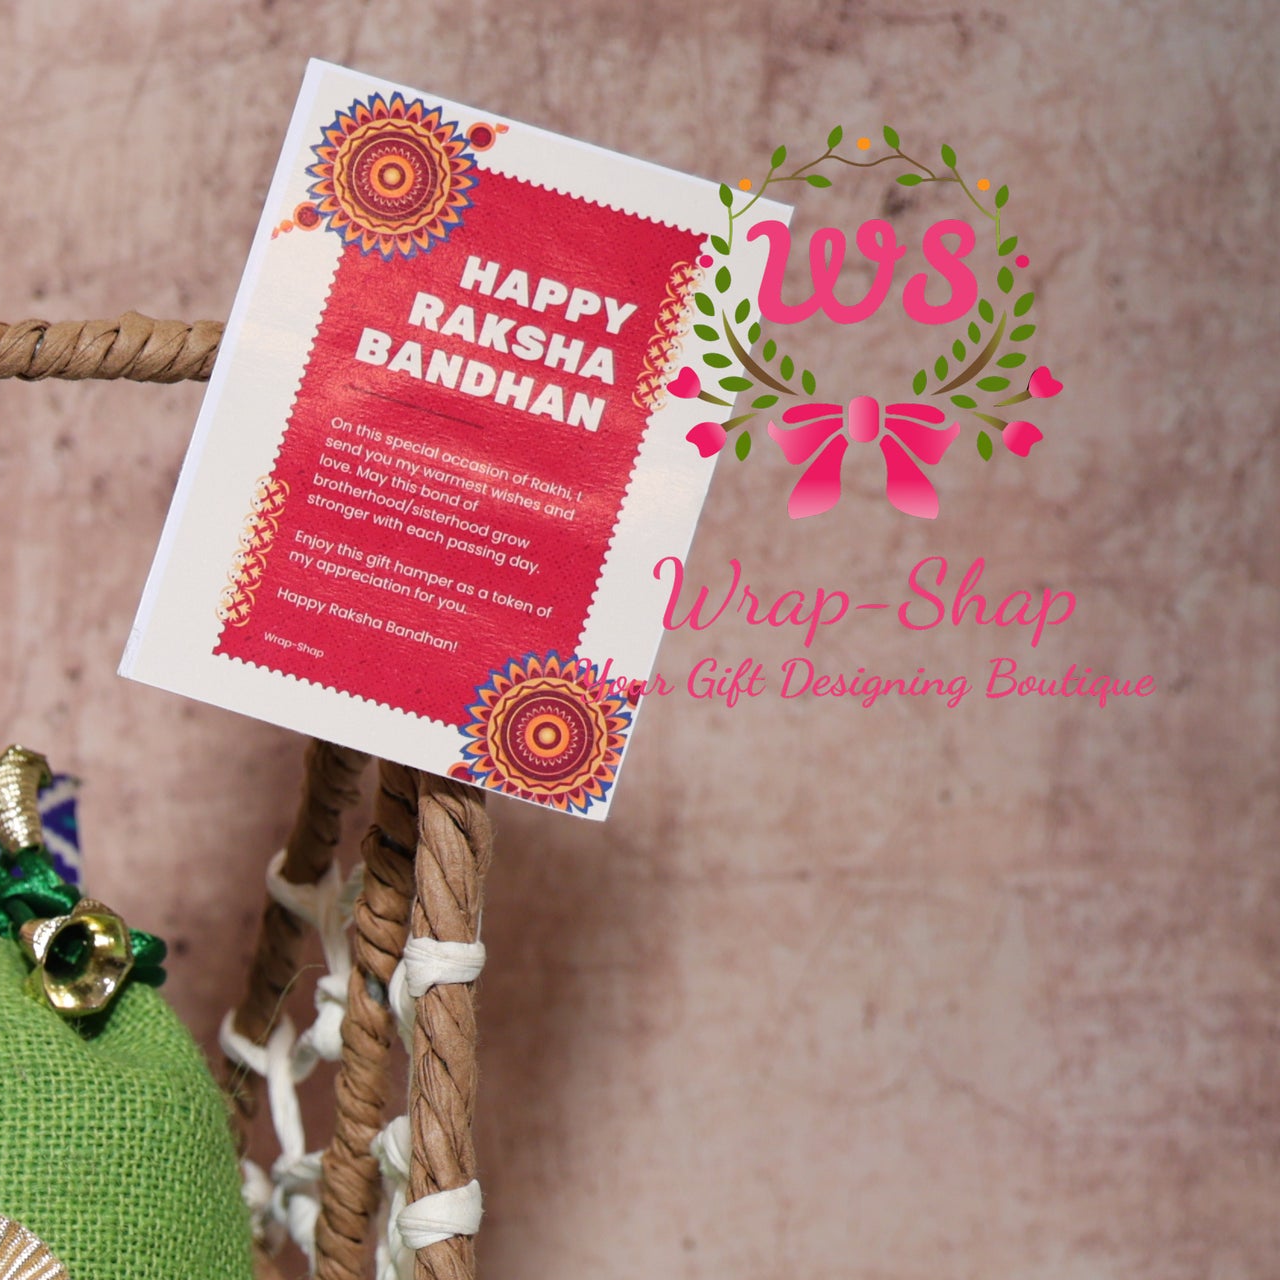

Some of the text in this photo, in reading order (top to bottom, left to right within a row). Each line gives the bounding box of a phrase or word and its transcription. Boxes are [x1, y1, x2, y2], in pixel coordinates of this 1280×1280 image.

[459, 255, 638, 335] HAPPY
[408, 291, 615, 385] RAKSHA
[354, 327, 606, 432] BANDHAN
[319, 453, 480, 513] love. May this bond of
[325, 436, 575, 521] send you my warmest wishes and
[331, 417, 353, 433] On
[356, 424, 383, 442] this
[385, 433, 440, 461] special
[442, 452, 509, 481] occasion
[512, 470, 530, 487] of
[530, 476, 573, 501] Rakhi,
[307, 493, 540, 575] stronger with each passing day.
[312, 472, 530, 549] brotherhood/sisterhood grow
[289, 550, 467, 615] my appreciation for you.
[295, 529, 553, 619] Enjoy this gift hamper as a token of
[263, 630, 325, 660] Wrap-Shap
[276, 586, 459, 653] Happy Raksha Bandhan!
